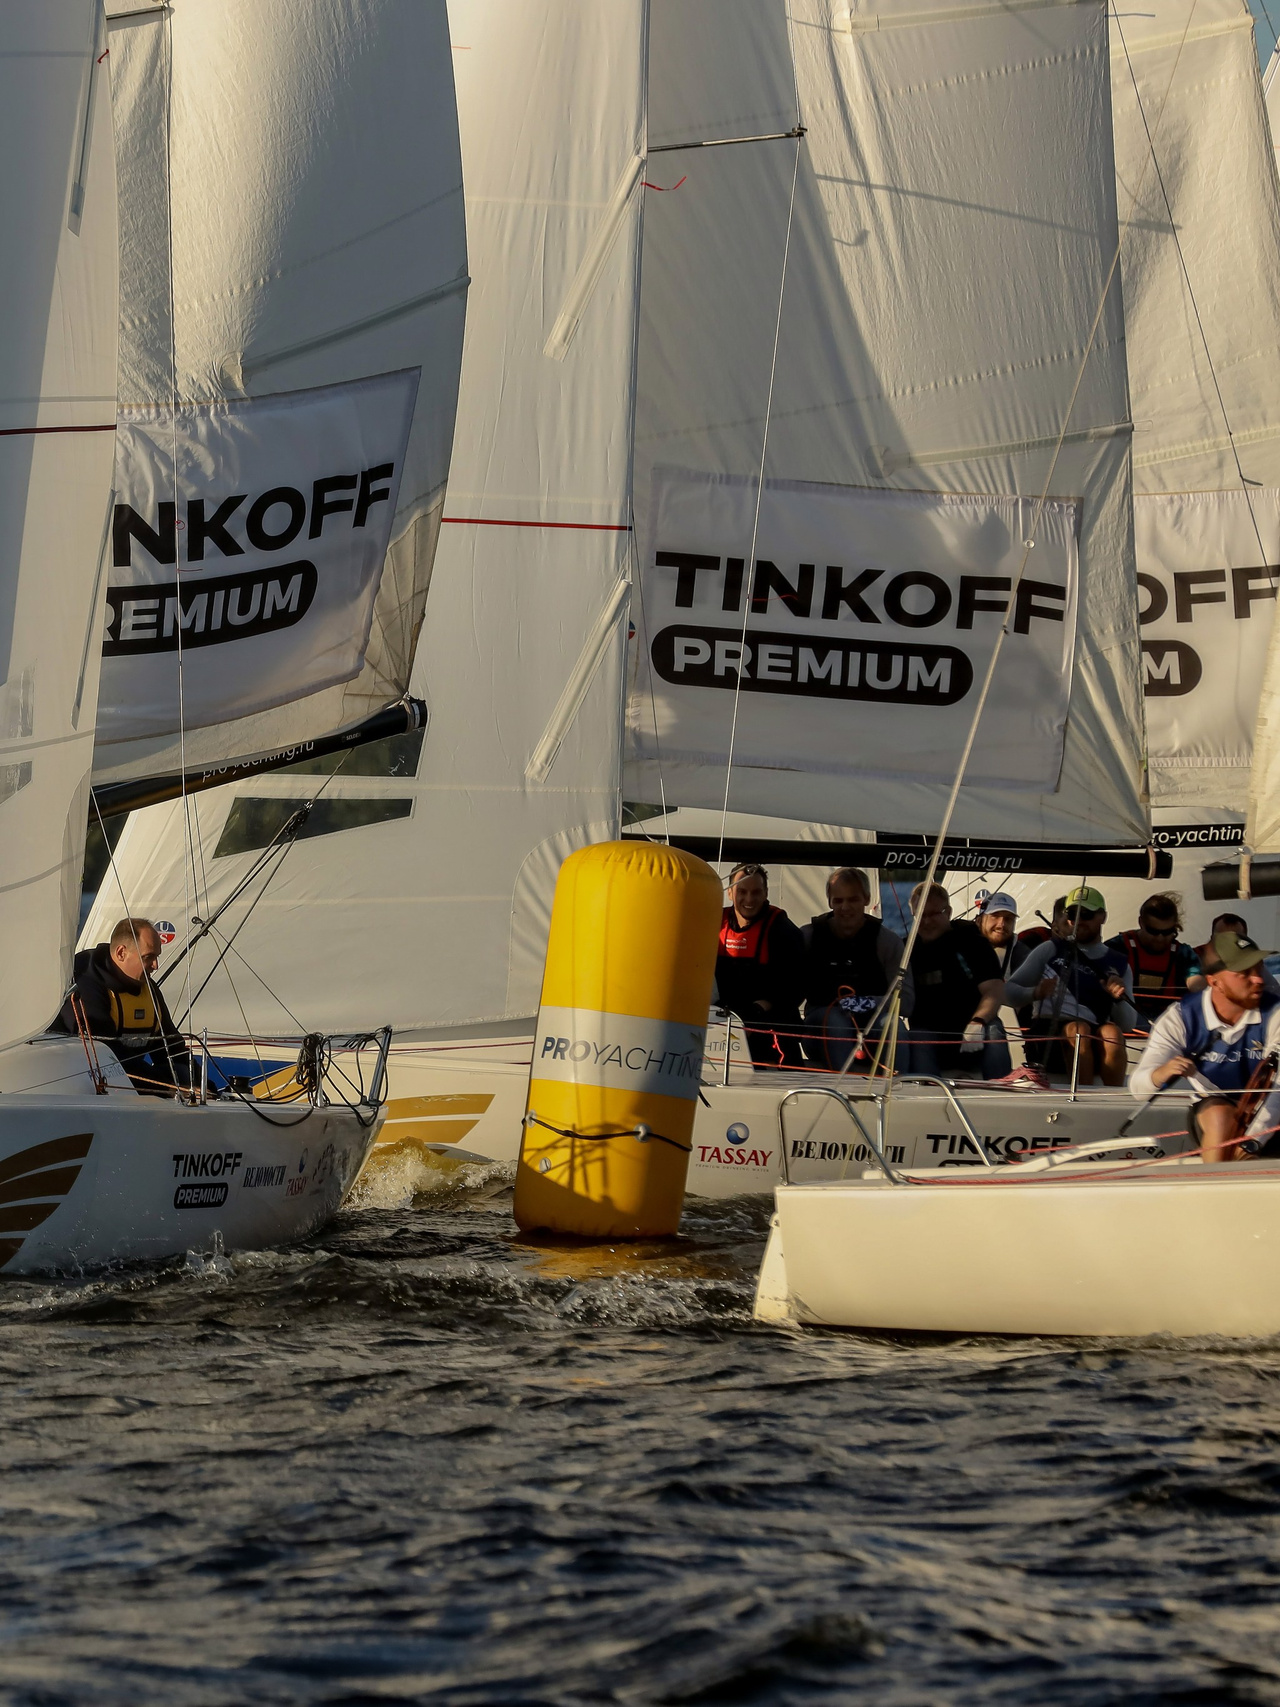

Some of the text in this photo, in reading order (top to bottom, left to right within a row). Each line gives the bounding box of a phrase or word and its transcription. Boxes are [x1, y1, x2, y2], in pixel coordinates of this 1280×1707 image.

[655, 551, 1066, 635] TINKOFF
[673, 636, 953, 693] PREMIUM
[202, 740, 315, 783] proyacng.ru
[883, 851, 1022, 871] pro-yachting.ru
[697, 1145, 773, 1167] TASSAY
[926, 1133, 1072, 1156] TINKOFF
[172, 1152, 243, 1177] TINKOFF
[176, 1186, 226, 1204] PREMIUM
